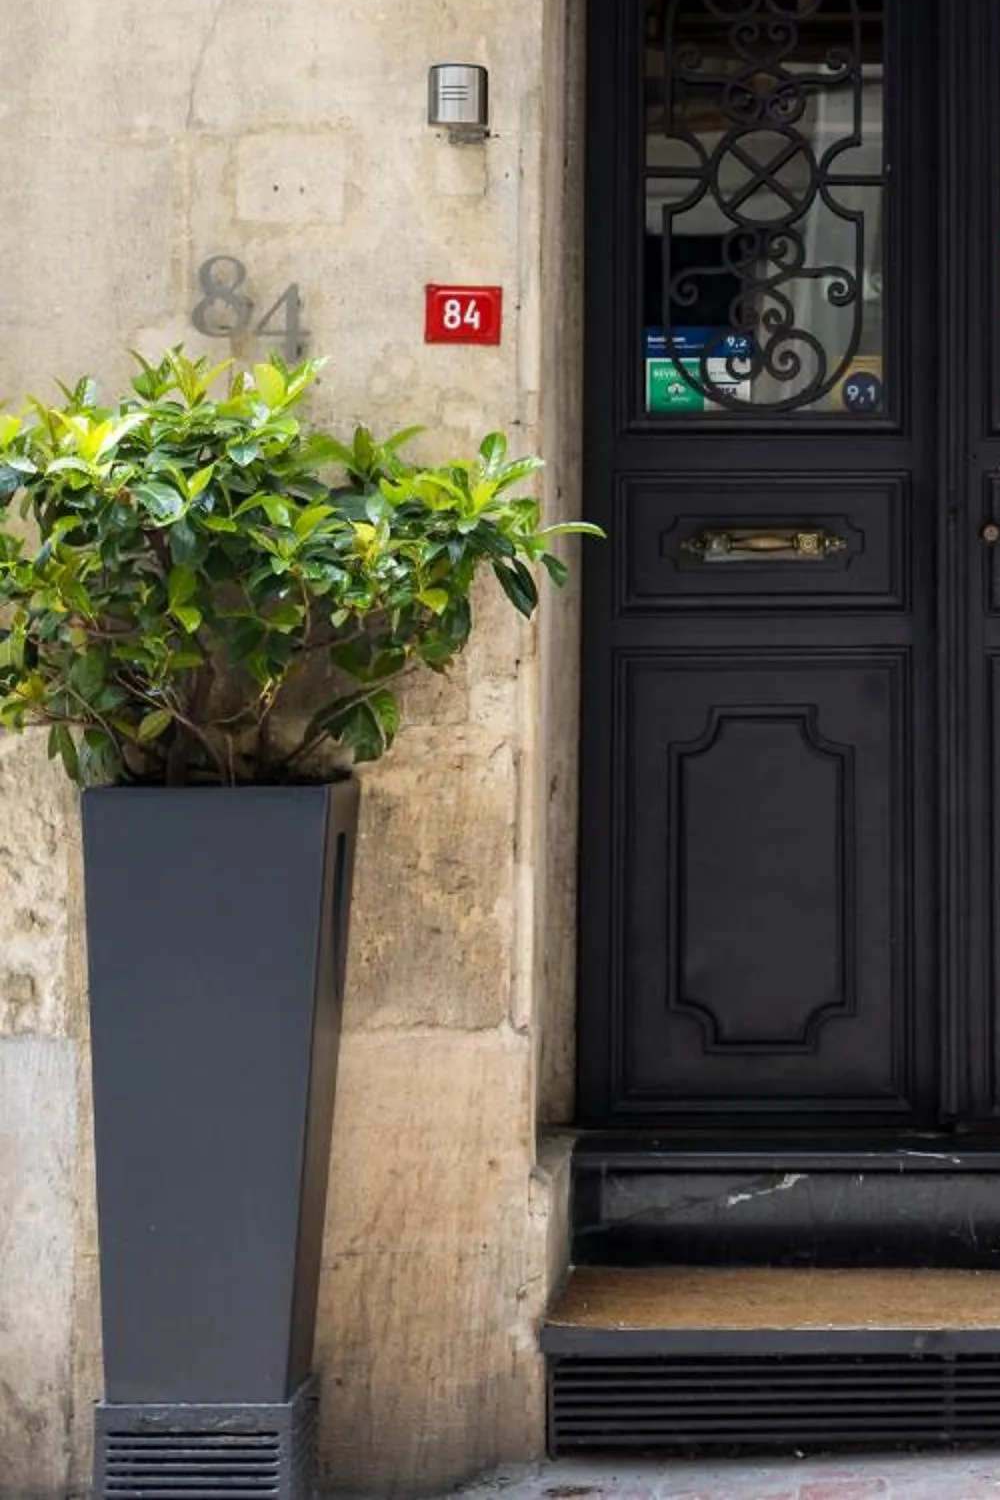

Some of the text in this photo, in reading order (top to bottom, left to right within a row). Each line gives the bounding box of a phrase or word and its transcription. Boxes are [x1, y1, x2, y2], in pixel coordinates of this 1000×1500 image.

[191, 254, 312, 361] 84
[443, 298, 481, 330] 84
[846, 384, 875, 405] 9,1
